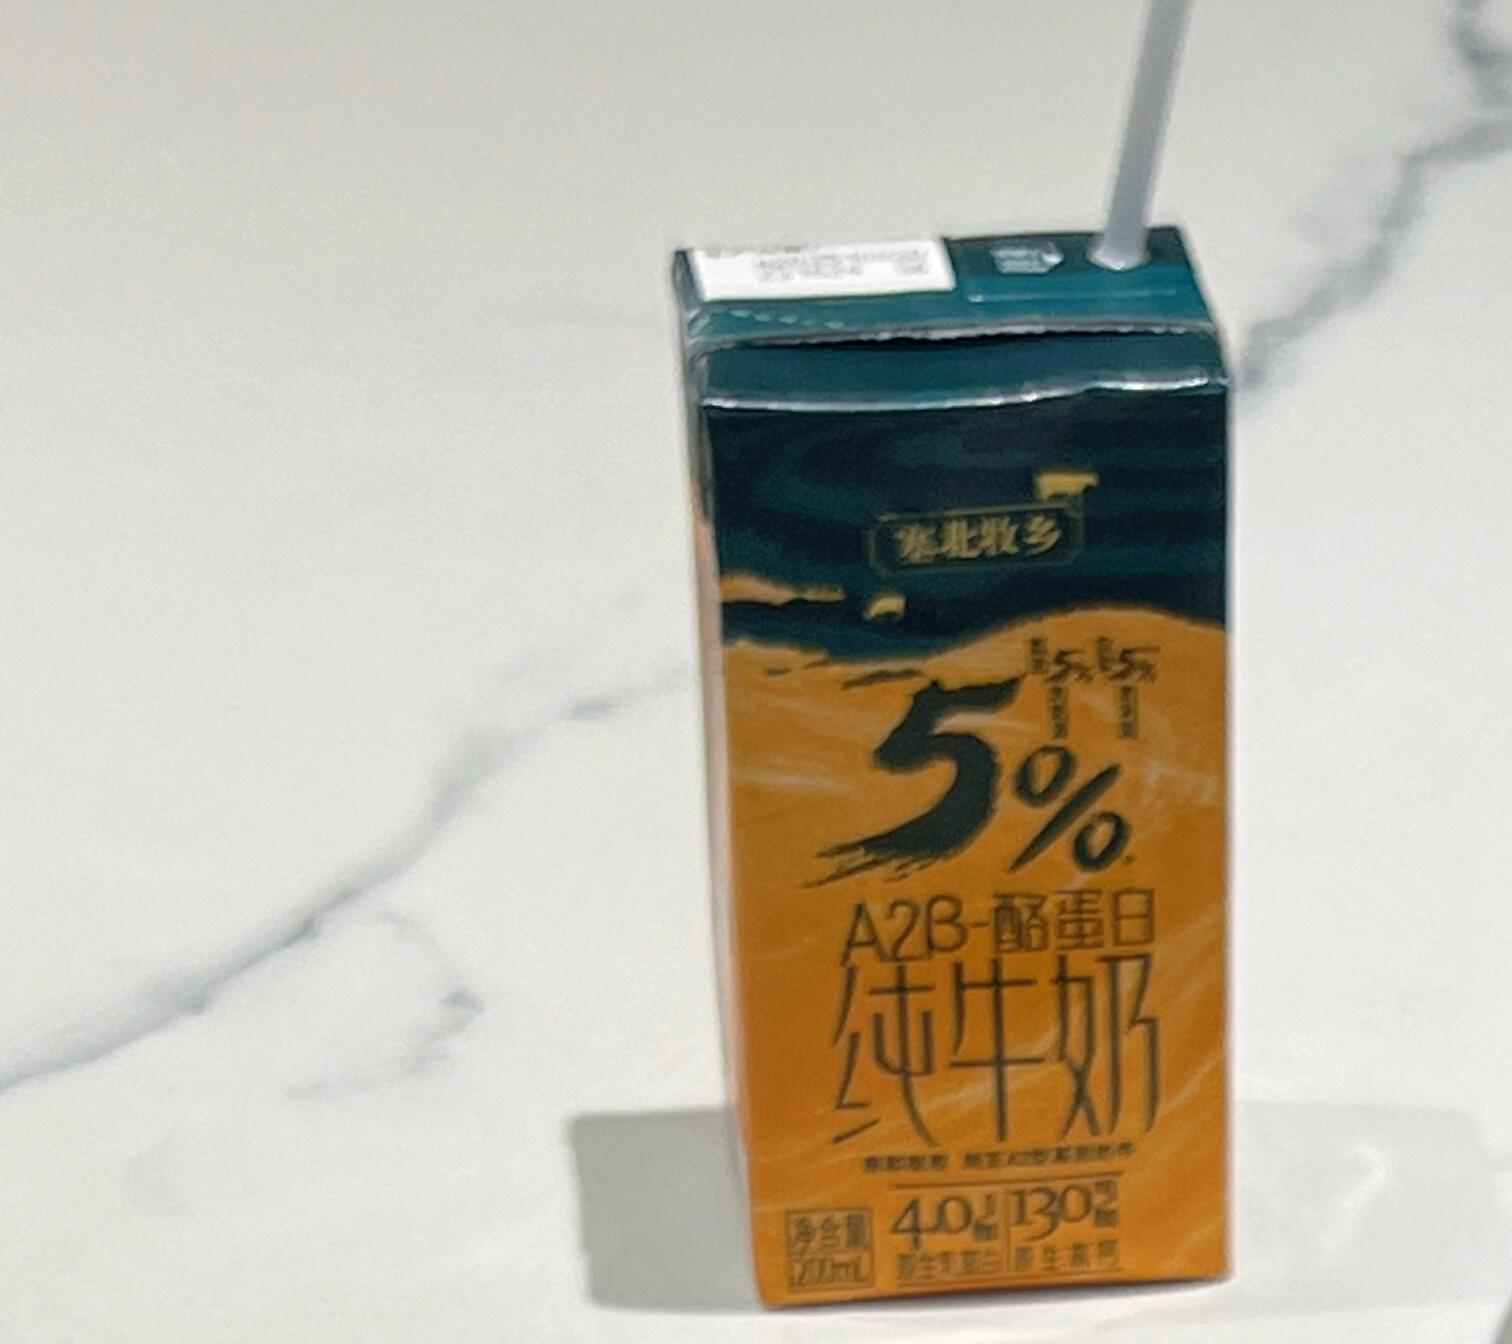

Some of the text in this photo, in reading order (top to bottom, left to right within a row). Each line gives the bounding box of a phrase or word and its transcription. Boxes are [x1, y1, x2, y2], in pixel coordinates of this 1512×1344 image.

[806, 674, 1132, 885] 5%
[831, 953, 1161, 1147] 纯牛奶
[1009, 1184, 1092, 1242] 130
